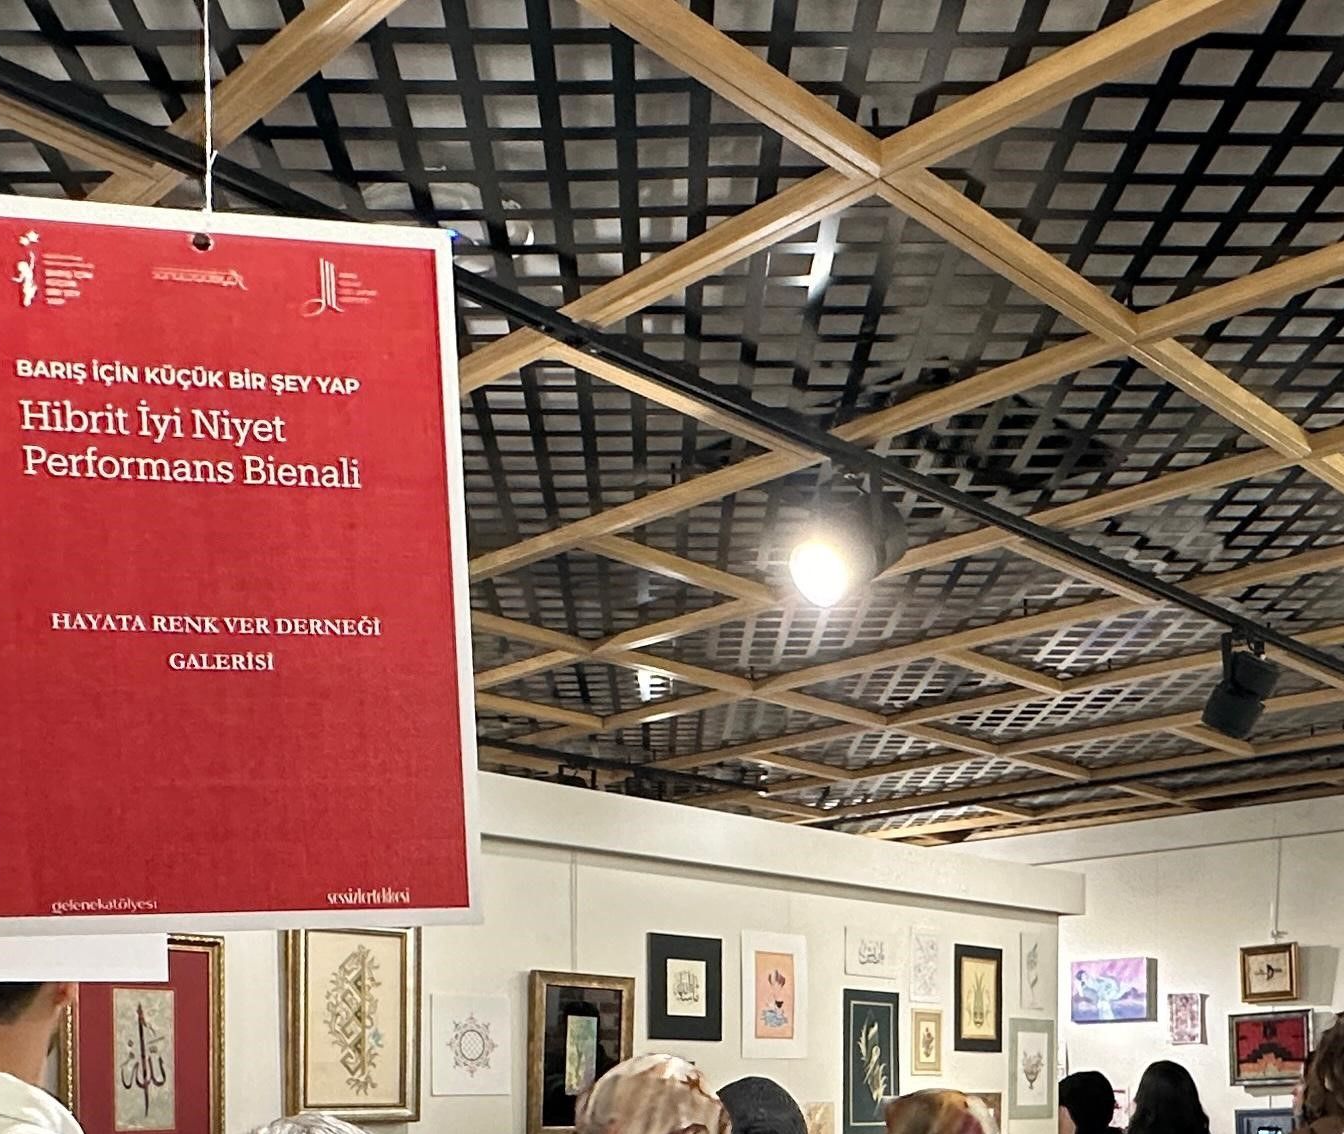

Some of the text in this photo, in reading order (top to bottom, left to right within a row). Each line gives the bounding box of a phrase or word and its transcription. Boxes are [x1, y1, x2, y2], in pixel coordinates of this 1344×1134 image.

[16, 359, 361, 396] BARIŞ İÇİN KÜÇÜK BİR ŞEY YAP
[19, 399, 287, 447] Hibrit İyi Niyet
[22, 445, 362, 489] Performans Bienali
[51, 612, 382, 637] HAYATA RENK VER DERNEĞİ
[169, 650, 275, 671] GALERİSİ
